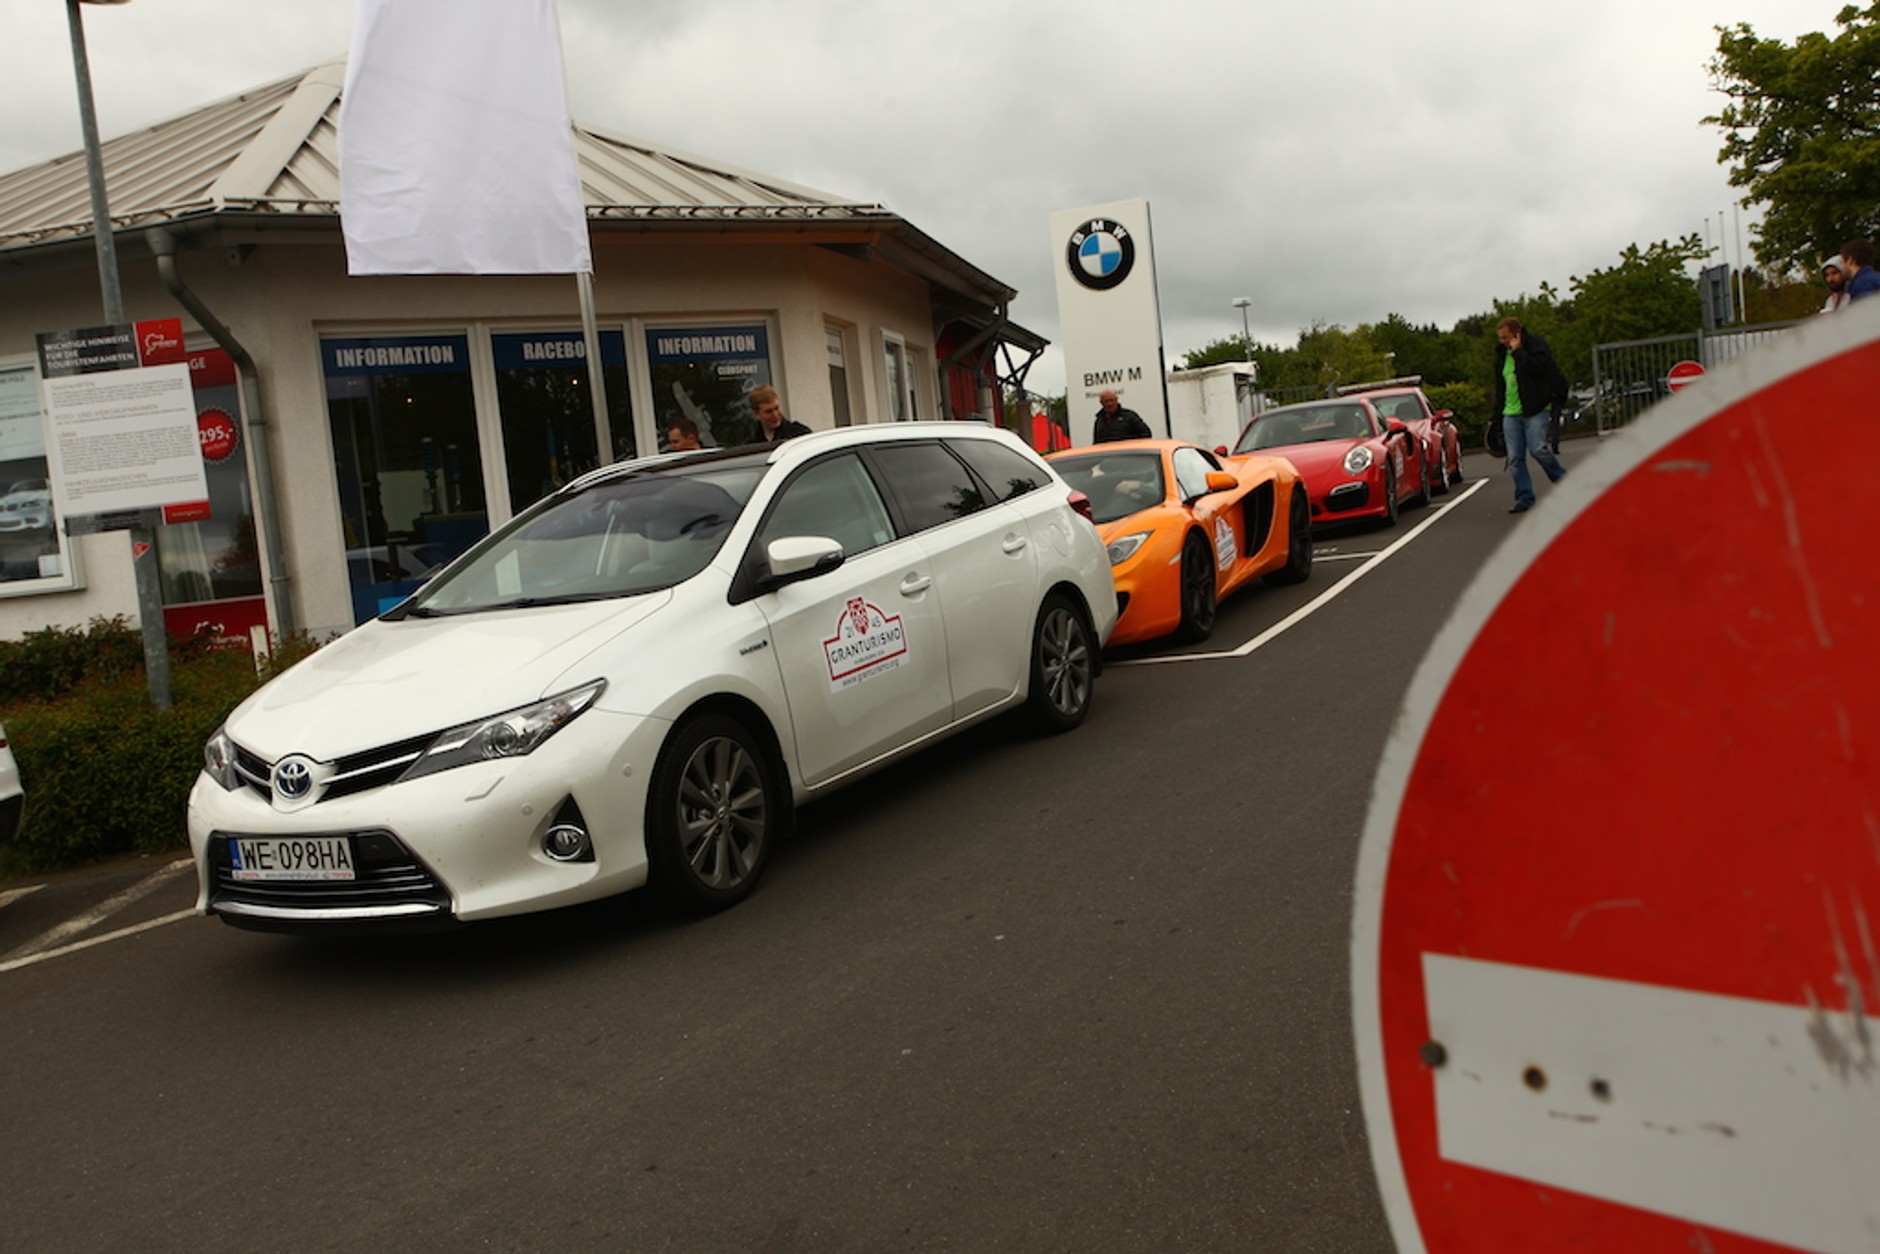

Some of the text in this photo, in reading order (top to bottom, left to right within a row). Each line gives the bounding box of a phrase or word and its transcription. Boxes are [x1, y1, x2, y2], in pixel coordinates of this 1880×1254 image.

[1073, 220, 1127, 246] BMW
[44, 334, 130, 351] WICHTIGE HINWEISE
[522, 340, 586, 360] RACEBO
[658, 335, 756, 355] INFORMATION
[46, 352, 135, 369] TOURISTENFAHRTEN
[64, 348, 79, 358] DIE
[189, 357, 206, 369] GE
[336, 345, 455, 368] INFORMATION
[717, 364, 758, 375] CLUBSPORT
[1084, 366, 1142, 387] BMW M
[831, 628, 901, 664] GRANTURISMO
[241, 840, 351, 869] WE 098HA
